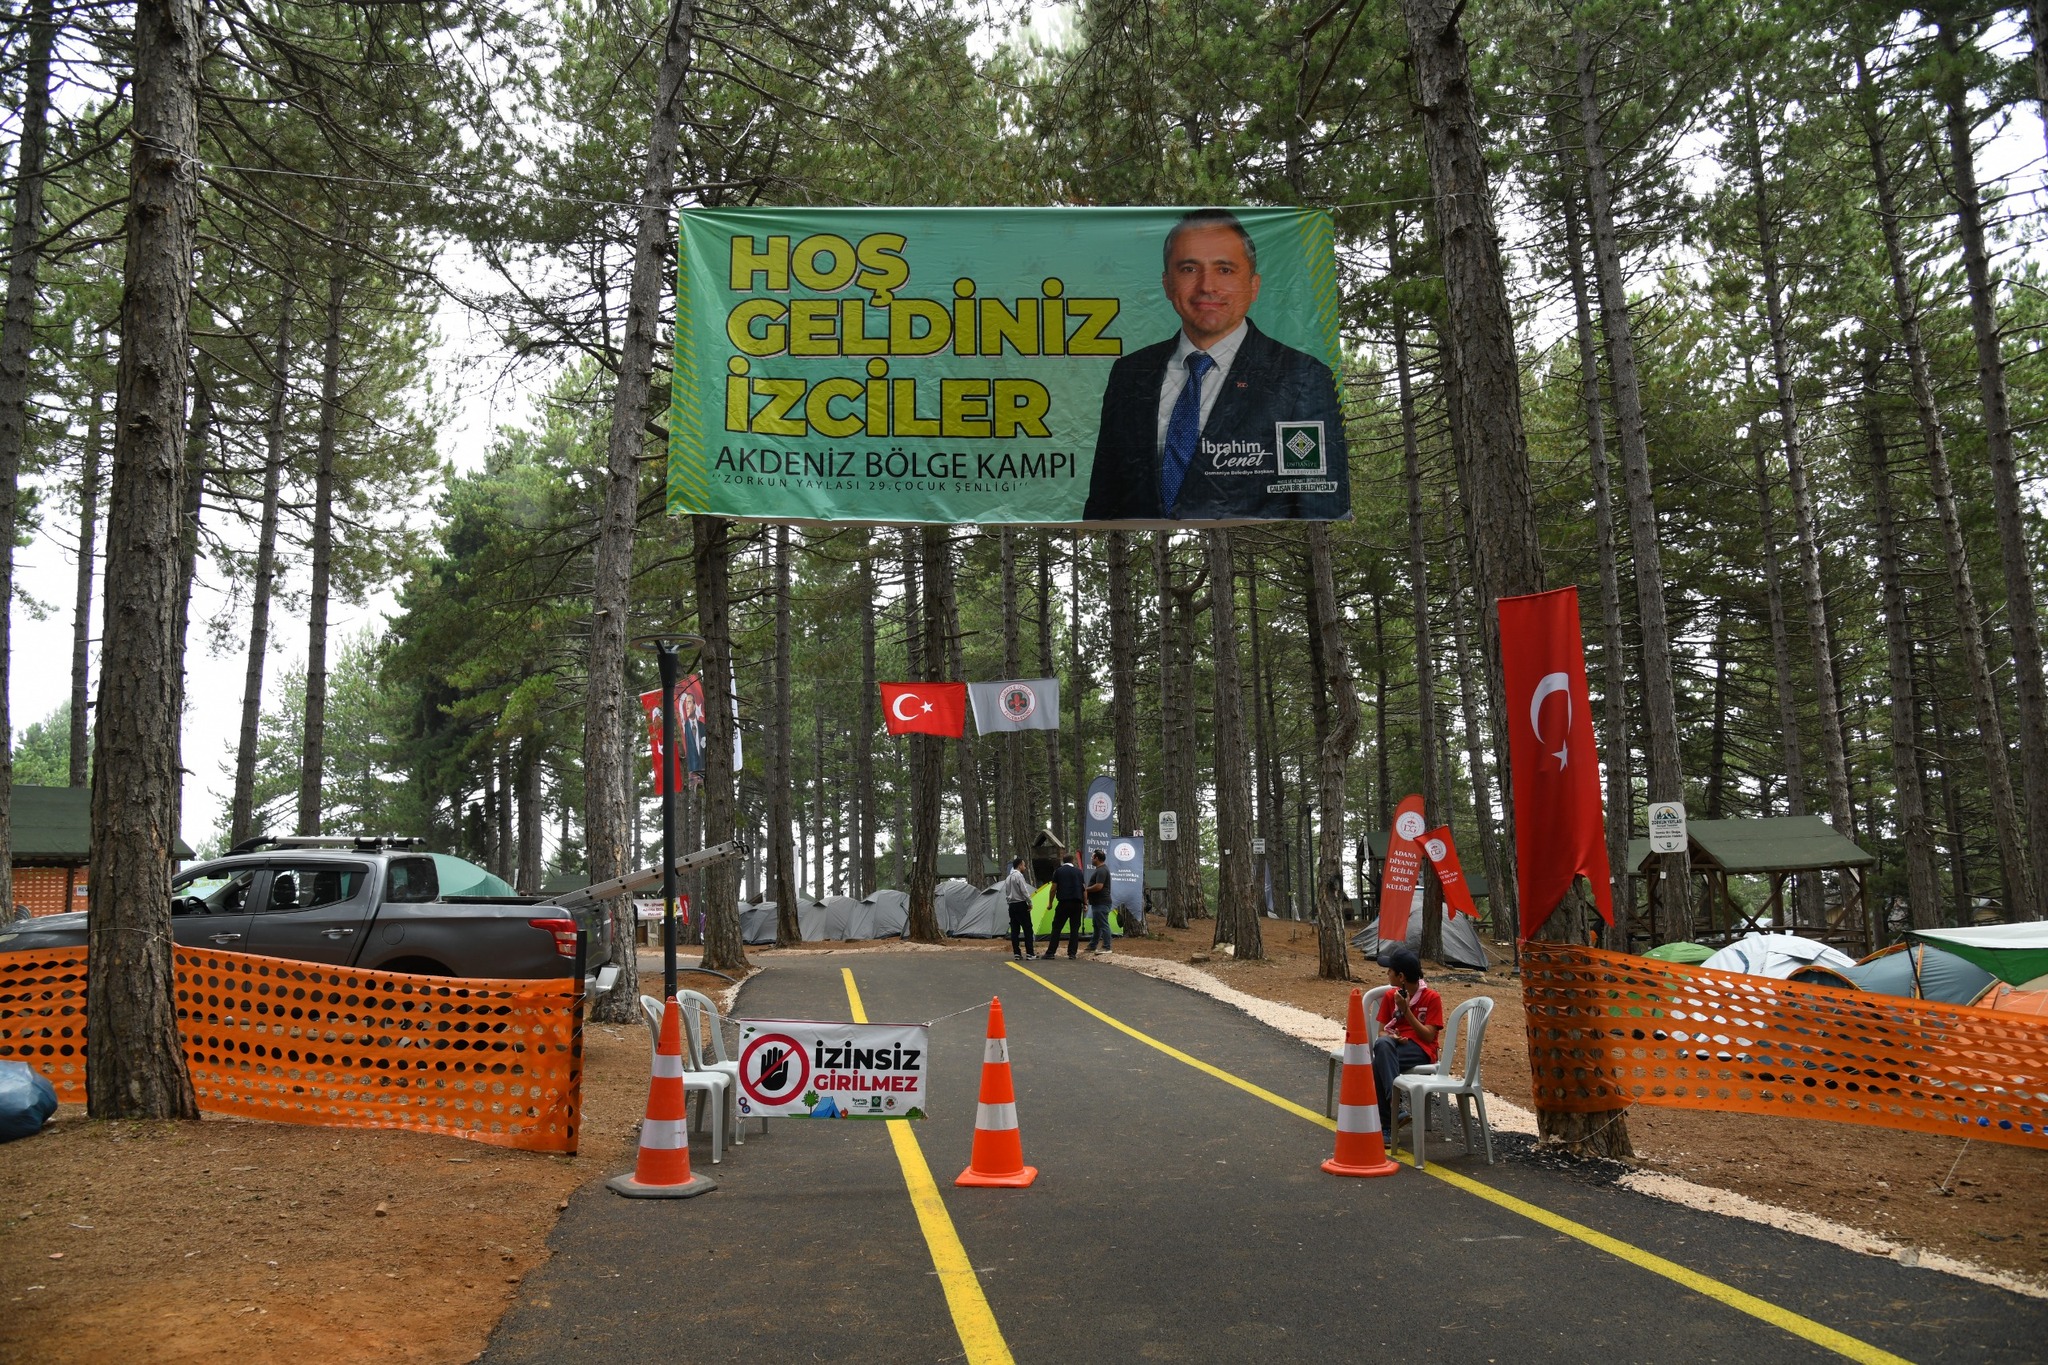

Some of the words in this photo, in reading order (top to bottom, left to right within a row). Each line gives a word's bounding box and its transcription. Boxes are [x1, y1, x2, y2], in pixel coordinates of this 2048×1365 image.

[729, 233, 911, 307] HOŞ
[726, 277, 1121, 358] GELDİNİZ
[725, 355, 1053, 437] İZCİLER
[1201, 438, 1260, 454] İbrahim
[714, 446, 856, 477] AKDENİZ
[866, 447, 967, 478] BÖLGE
[977, 453, 1075, 479] KAMPI
[1212, 449, 1273, 469] Çenet
[797, 480, 860, 490] YAYLASI
[869, 481, 946, 493] 29.ÇOCUK
[1086, 839, 1110, 847] DİYANET
[1389, 858, 1419, 867] DİYANET
[1394, 850, 1417, 859] ADANA
[1390, 866, 1414, 876] İZCİLİK
[1392, 875, 1410, 883] SPOR
[1386, 884, 1412, 892] KULÜBÜ
[815, 1040, 921, 1071] İZİNSİZ
[813, 1069, 918, 1092] GİRİLMEZ
